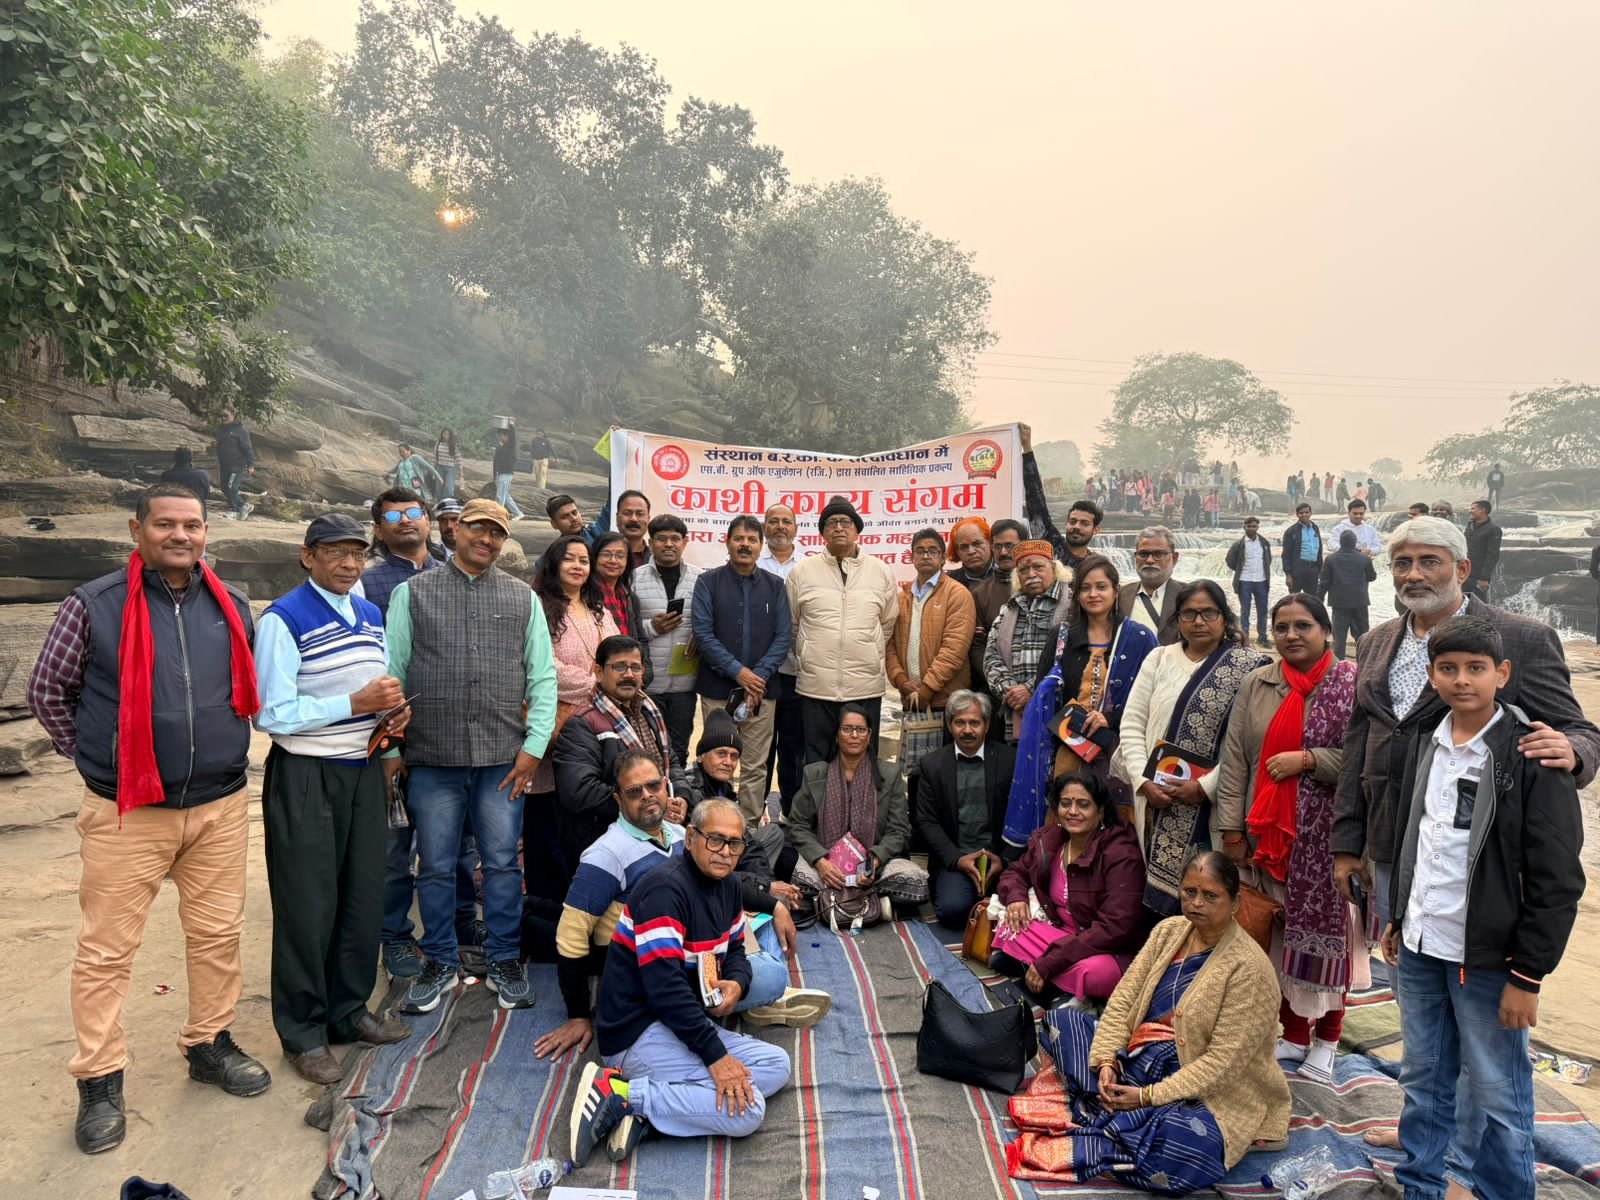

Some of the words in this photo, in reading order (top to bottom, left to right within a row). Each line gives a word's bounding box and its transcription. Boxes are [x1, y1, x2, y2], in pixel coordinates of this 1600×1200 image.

[704, 447, 763, 462] संस्थान
[934, 444, 950, 457] में
[747, 464, 765, 476] ऑफ
[768, 466, 802, 478] एजुकेशन
[806, 466, 832, 479] (रजि.)
[836, 467, 852, 478] द्वारा
[854, 465, 886, 477] संचालित
[889, 463, 927, 476] साहित्यिक
[929, 462, 953, 473] प्रकल्प
[670, 480, 768, 515] काशी
[884, 478, 988, 513] संगम
